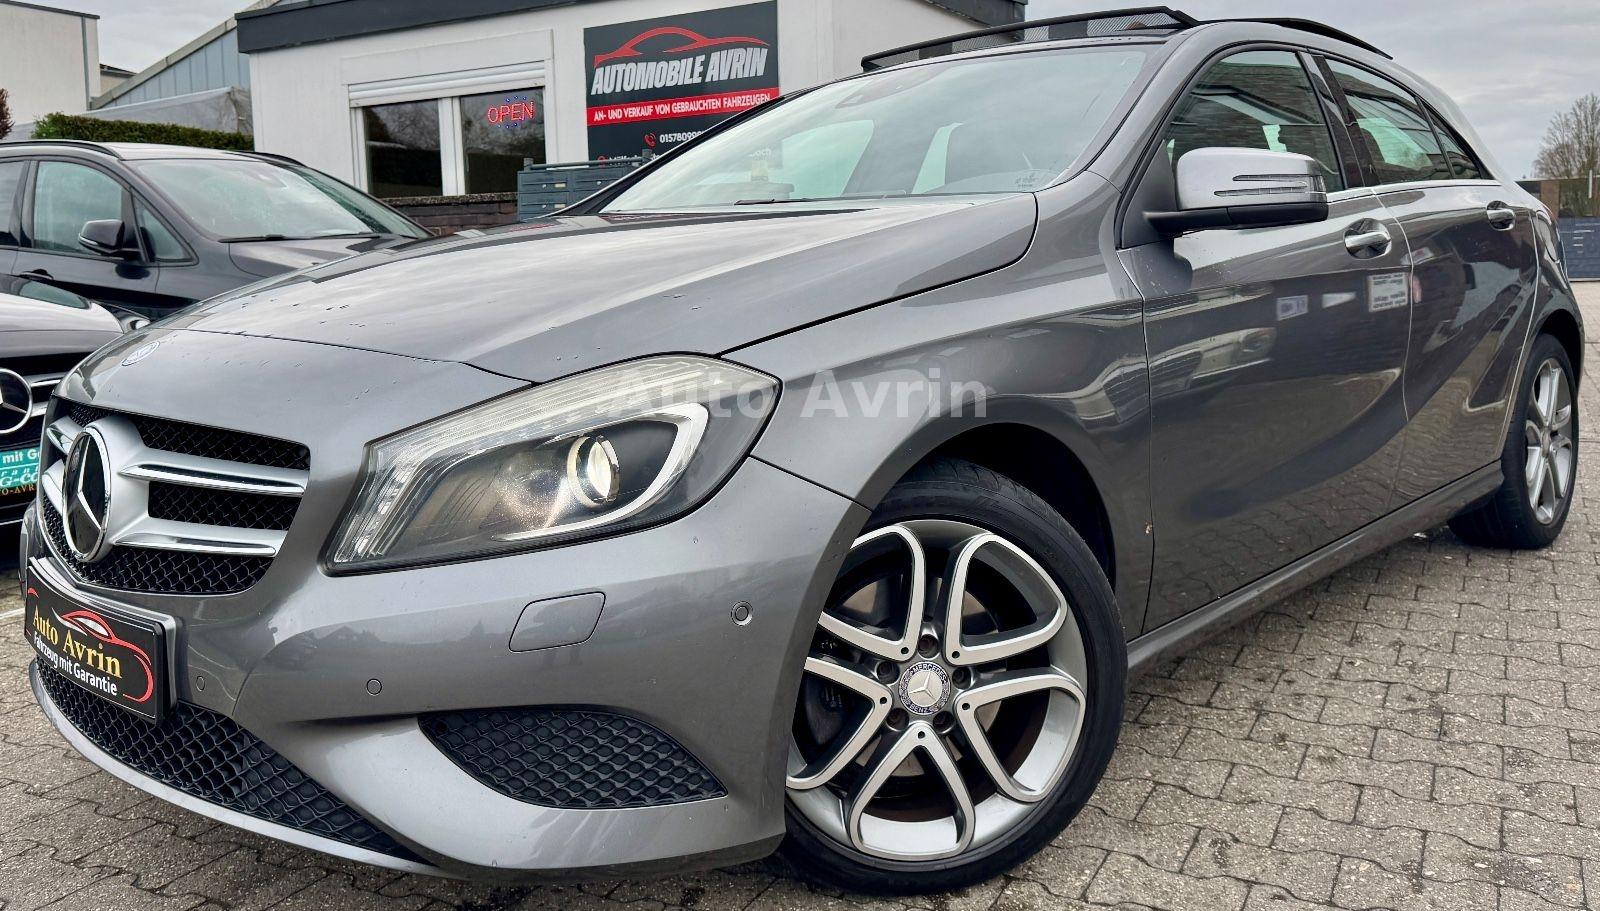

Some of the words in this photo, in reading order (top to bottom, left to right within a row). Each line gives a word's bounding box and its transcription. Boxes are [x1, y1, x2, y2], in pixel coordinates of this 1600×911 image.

[591, 54, 706, 95] AUTOMOBILE
[705, 48, 768, 83] AVRIN
[488, 101, 534, 123] OPEN
[594, 111, 606, 121] AN-
[607, 109, 622, 120] UND
[624, 106, 654, 118] VERKAUF
[655, 104, 671, 115] VON
[672, 98, 721, 113] GEBRAUCHTEN
[723, 93, 770, 108] FAHRZEUGEN
[2, 451, 23, 464] mit
[32, 605, 59, 646] Auto
[62, 629, 122, 679] Avrin
[33, 631, 58, 668] Fahrzeug
[59, 652, 73, 675] mit
[73, 662, 118, 696] Garantie
[912, 663, 946, 681] MERCEDES
